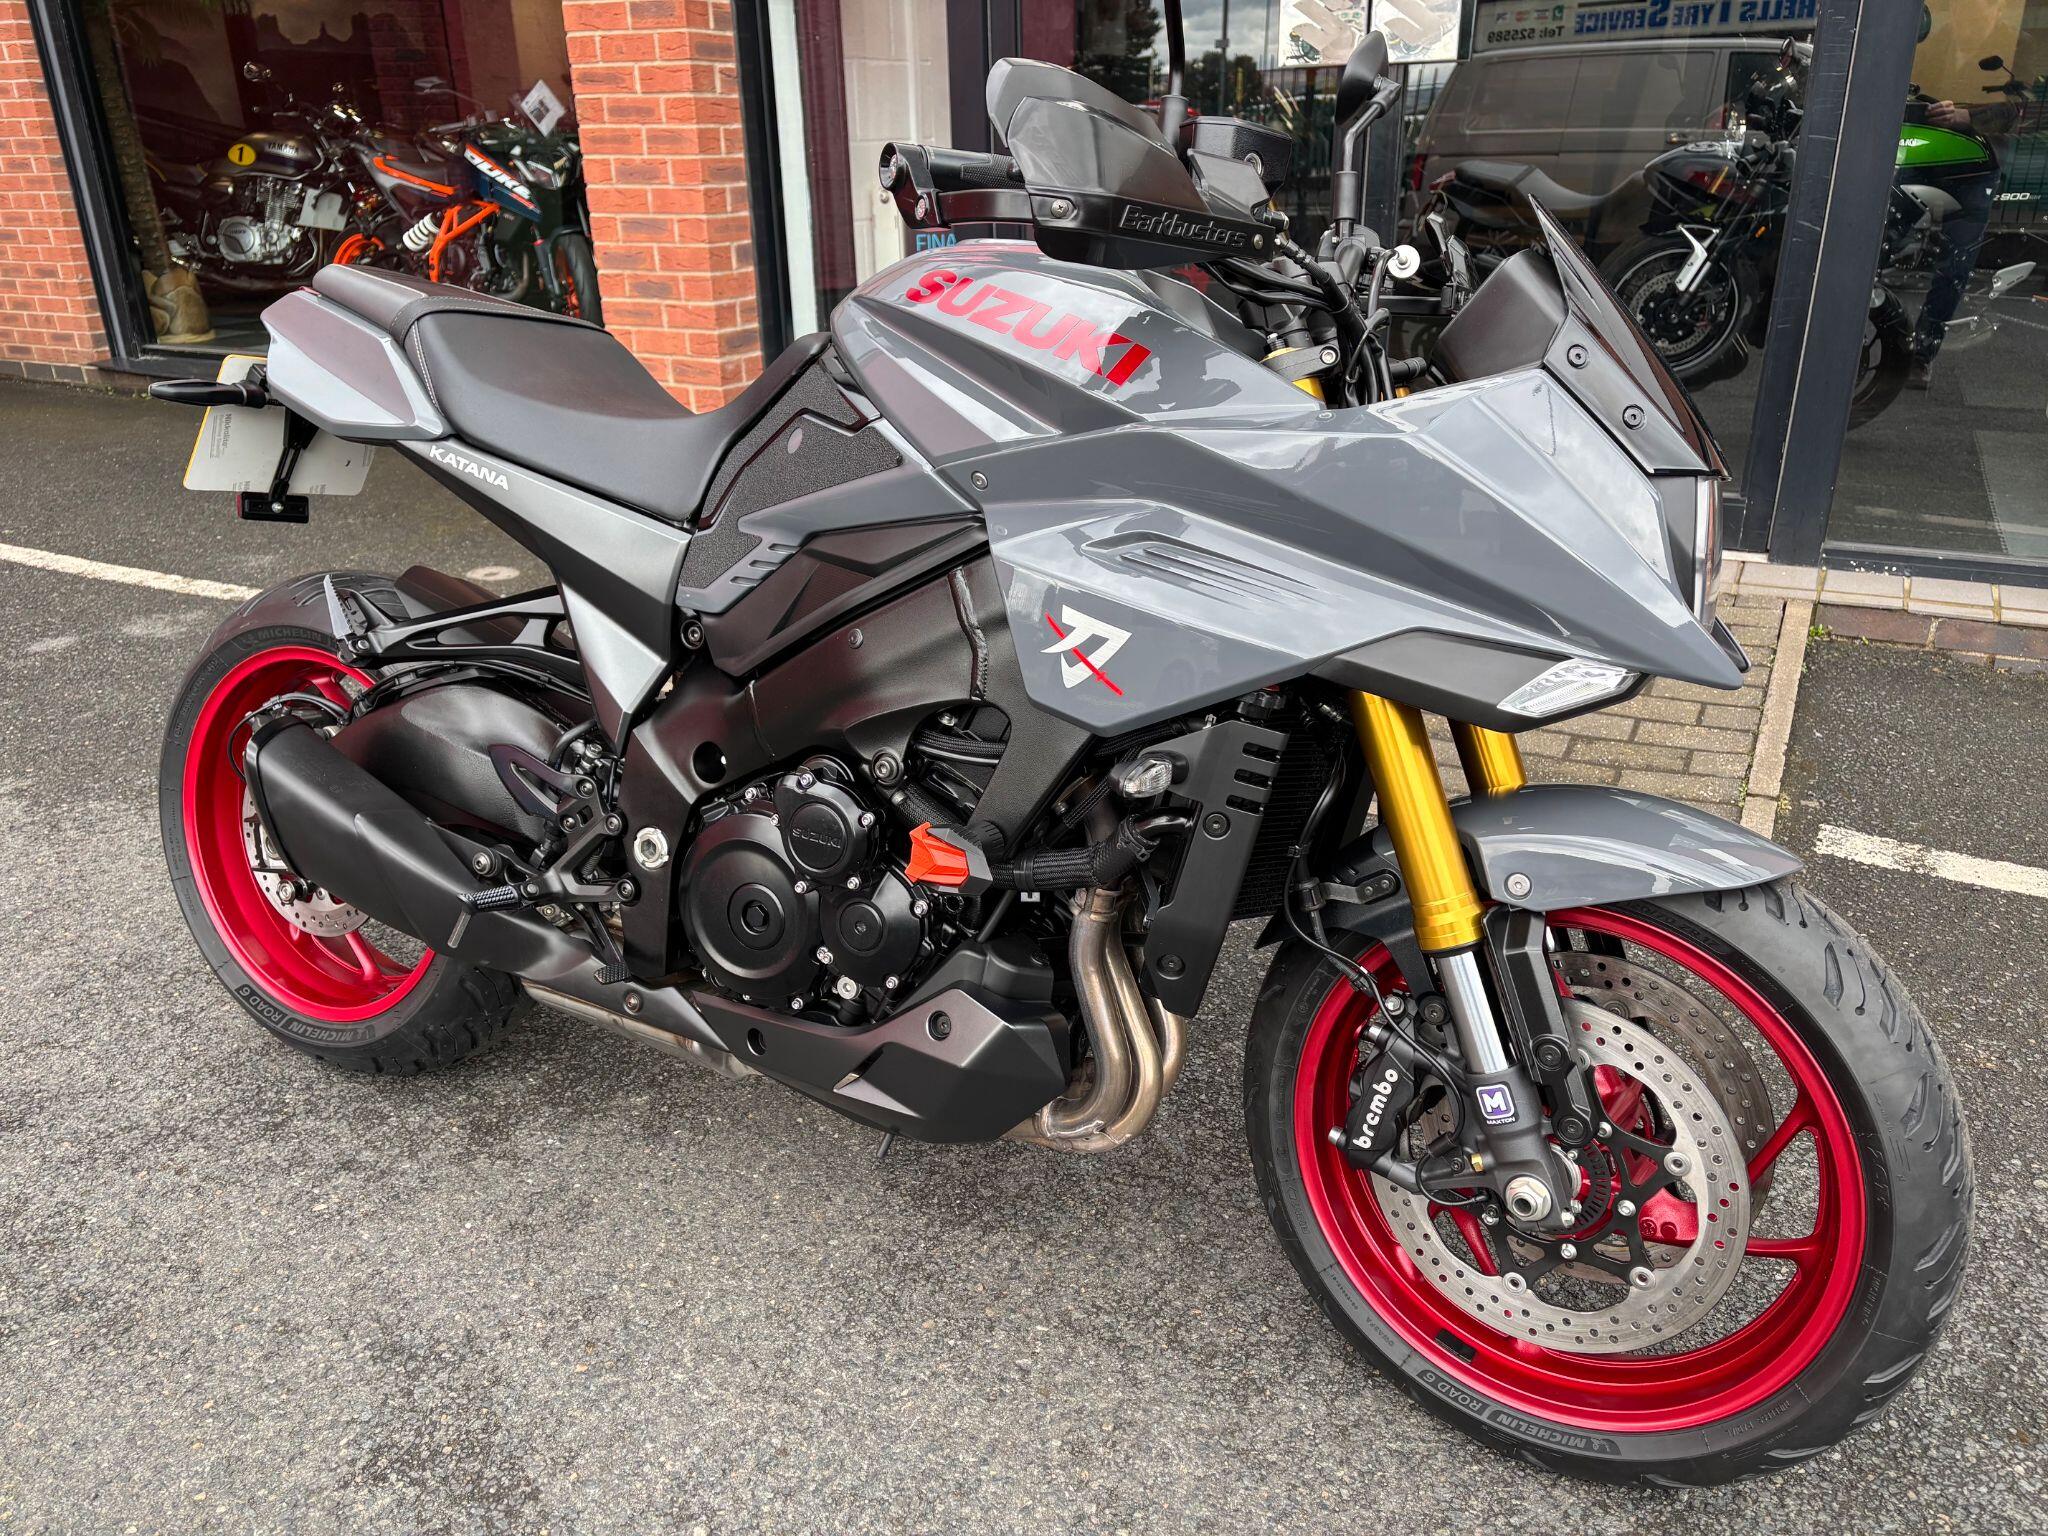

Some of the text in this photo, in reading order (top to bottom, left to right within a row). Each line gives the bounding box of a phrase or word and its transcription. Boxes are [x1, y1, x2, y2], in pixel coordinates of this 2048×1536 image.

[237, 146, 245, 162] 1
[1119, 203, 1248, 248] Barkbusters
[905, 268, 1152, 388] SUZUKI
[429, 444, 509, 491] KATANA
[239, 986, 284, 1022] ROAD 6
[288, 1021, 353, 1041] MICHELIN
[1352, 1068, 1399, 1149] brembo
[1481, 1091, 1508, 1114] M
[1486, 1117, 1516, 1126] MAXTON
[1423, 1372, 1483, 1413] ROAD 6
[1496, 1413, 1588, 1449] MICHELIN
